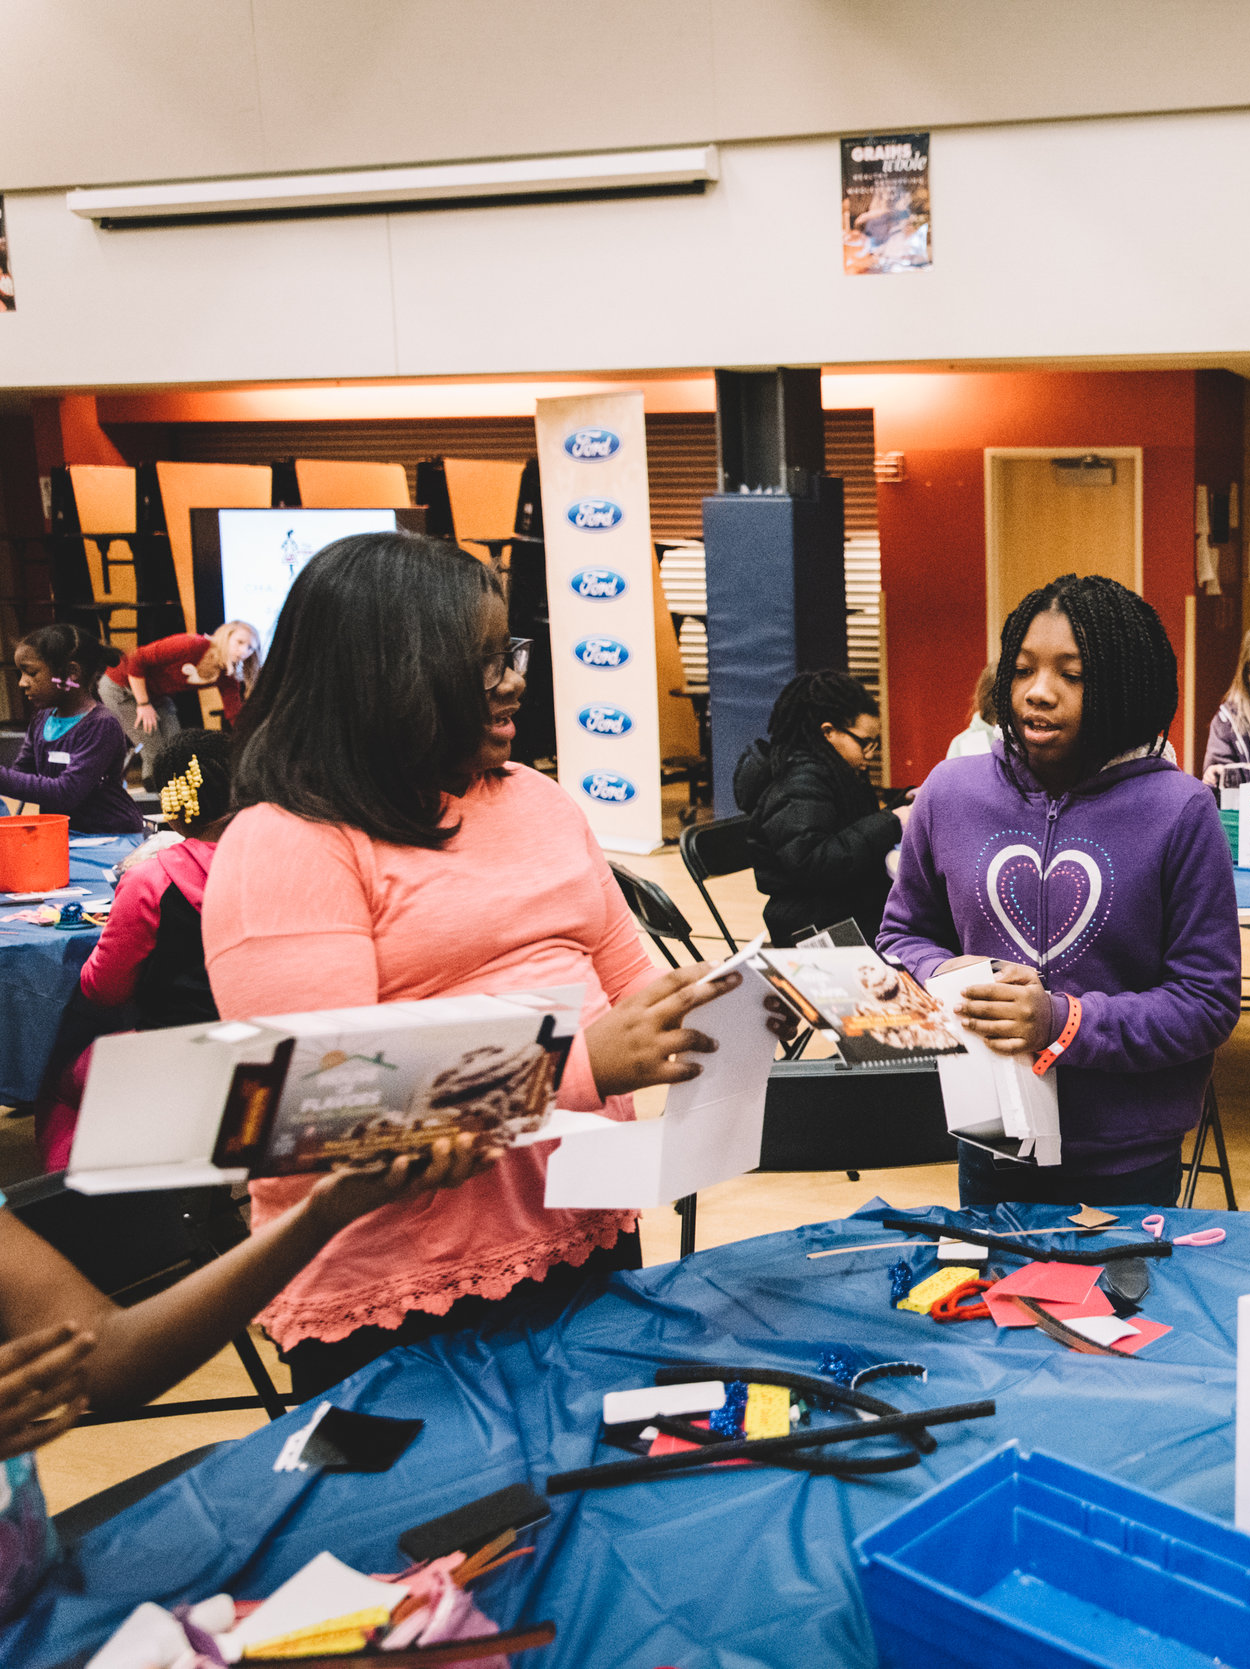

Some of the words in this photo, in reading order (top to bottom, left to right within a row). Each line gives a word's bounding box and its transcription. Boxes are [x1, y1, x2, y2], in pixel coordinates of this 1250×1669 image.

[572, 431, 612, 458] Ford
[575, 501, 615, 528] Ford
[579, 570, 618, 597] Ford
[582, 640, 621, 667] Ford
[586, 707, 625, 735] Ford
[589, 774, 628, 801] Ford
